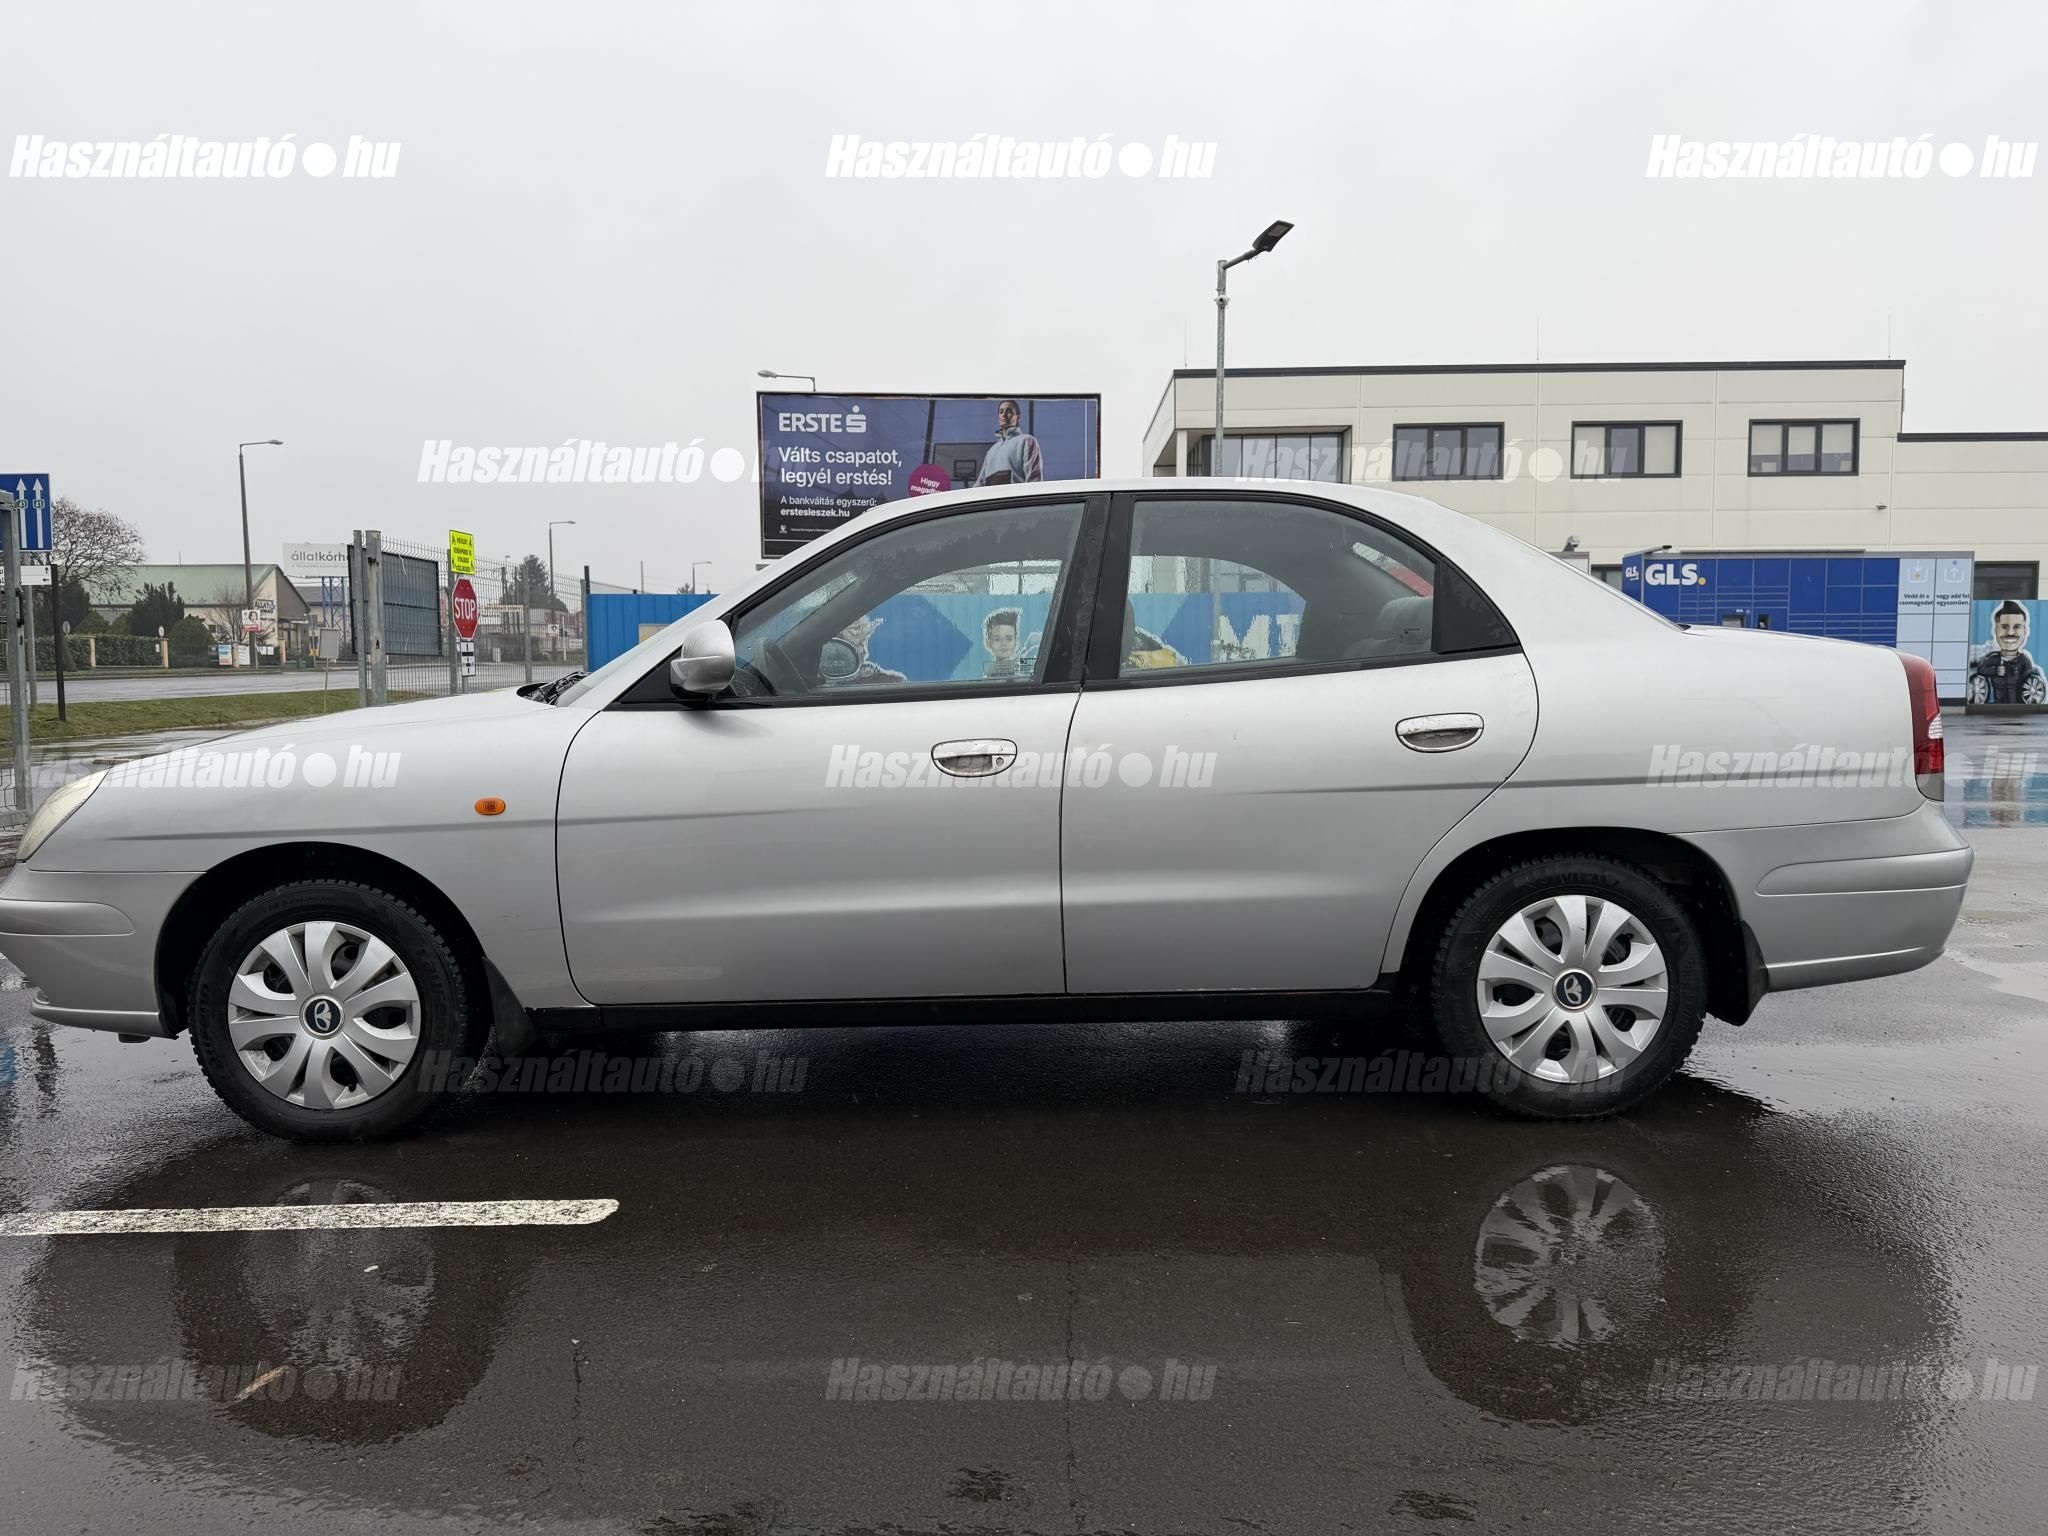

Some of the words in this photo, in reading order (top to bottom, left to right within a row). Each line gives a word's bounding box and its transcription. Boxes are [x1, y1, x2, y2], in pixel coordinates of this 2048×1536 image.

[778, 412, 843, 433] ERSTE
[778, 446, 821, 464] Válts
[825, 449, 903, 467] csapatot,
[781, 468, 831, 487] legyél
[836, 469, 893, 486] erstés!
[920, 477, 940, 488] Higgy
[780, 496, 788, 505] A
[789, 496, 835, 506] bankváltás
[291, 550, 348, 562] állatkórh
[454, 597, 476, 620] STOP
